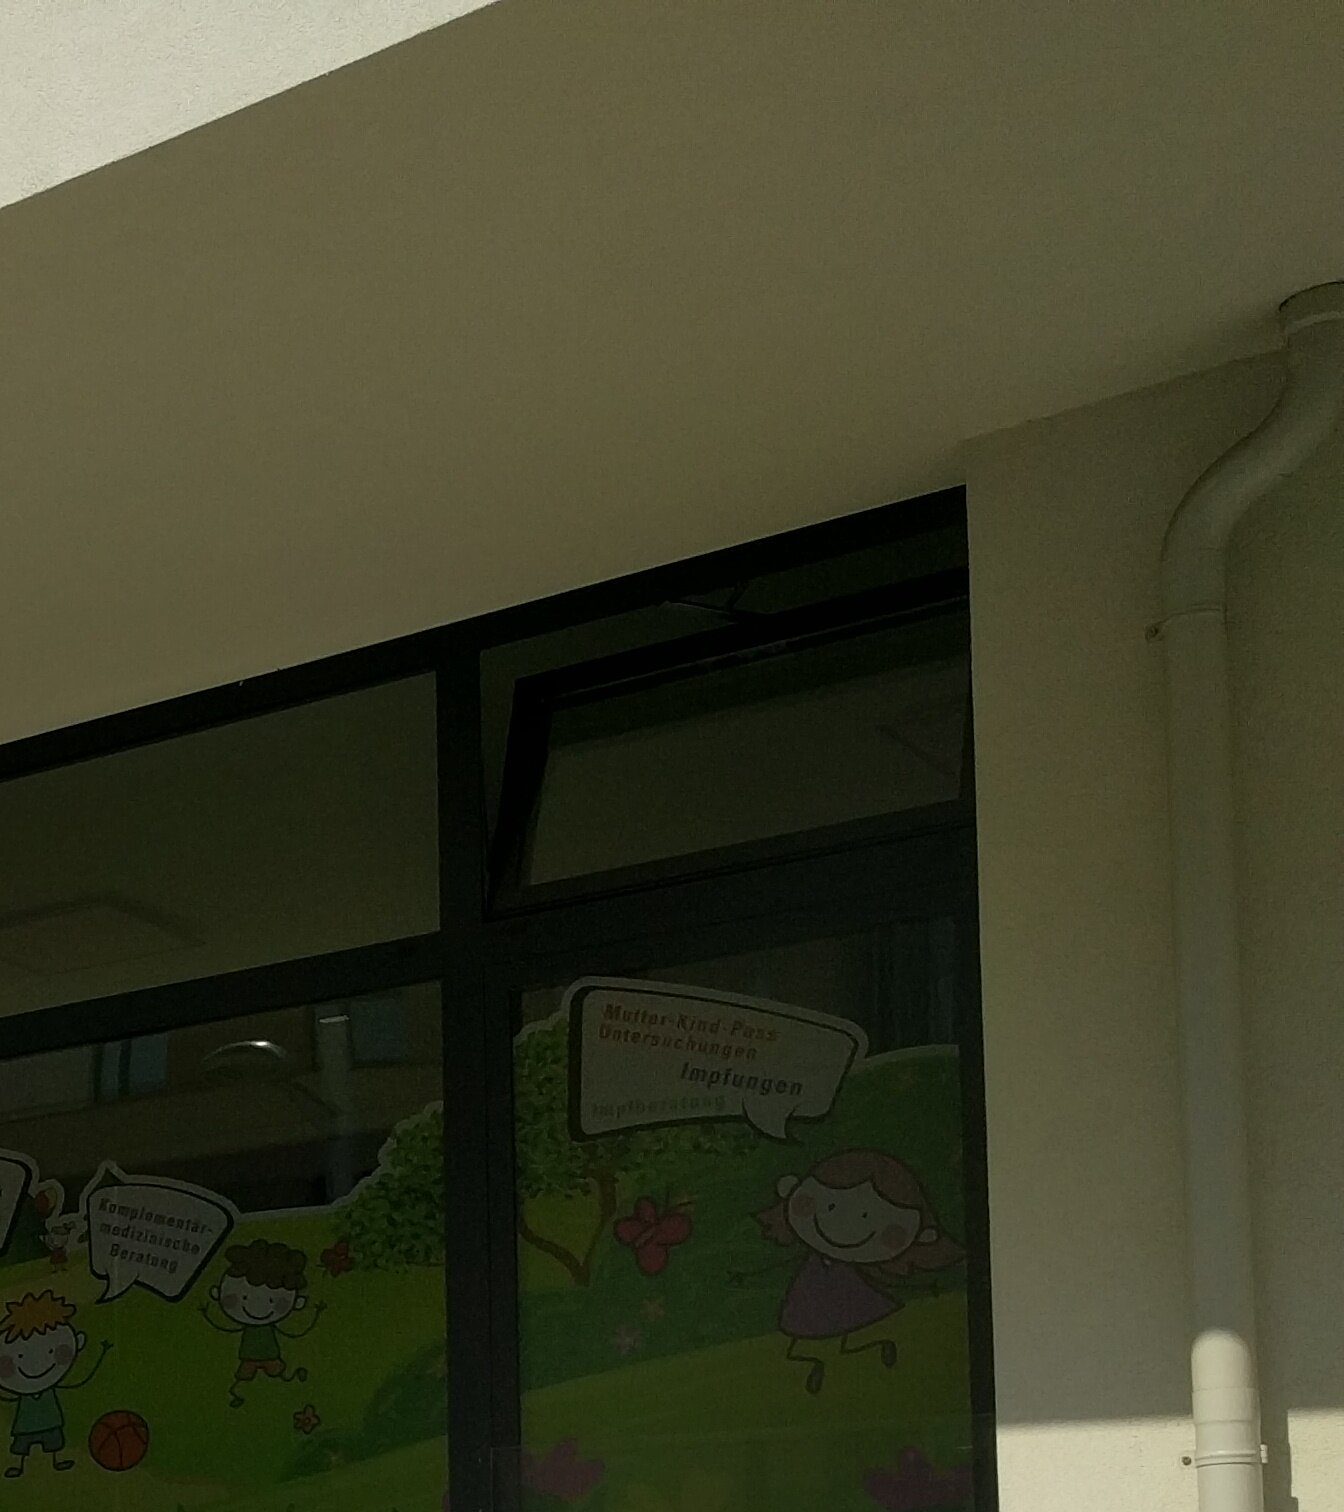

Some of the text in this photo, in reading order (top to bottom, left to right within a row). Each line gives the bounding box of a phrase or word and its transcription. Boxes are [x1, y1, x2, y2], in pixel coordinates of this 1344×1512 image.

[599, 1023, 758, 1060] Untersuchungen
[680, 1062, 803, 1096] Impfungen
[99, 1222, 201, 1255] medizinische
[109, 1243, 178, 1274] Beratung
